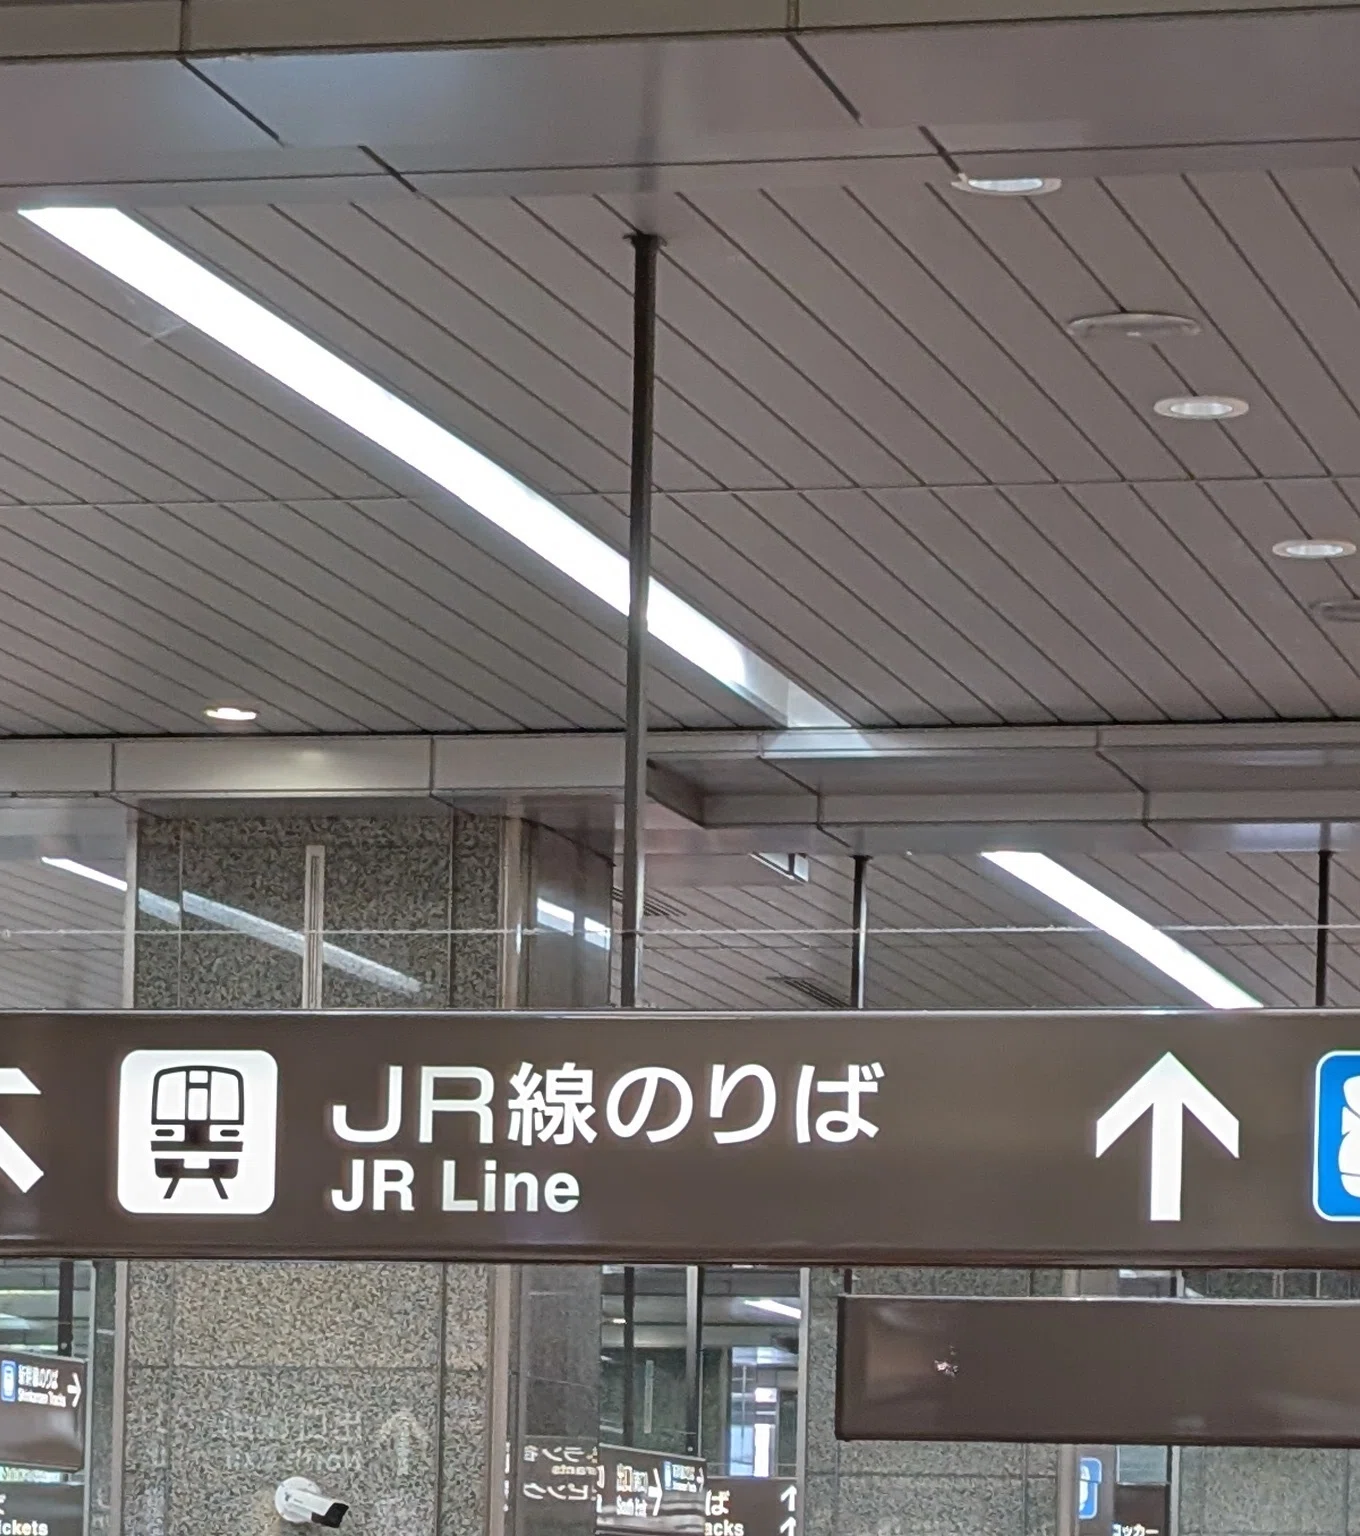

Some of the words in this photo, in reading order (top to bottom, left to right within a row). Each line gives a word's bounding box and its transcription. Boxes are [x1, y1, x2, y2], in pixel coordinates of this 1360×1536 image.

[333, 1062, 884, 1145] JR線のりば
[332, 1159, 414, 1211] JR
[443, 1160, 579, 1212] Line
